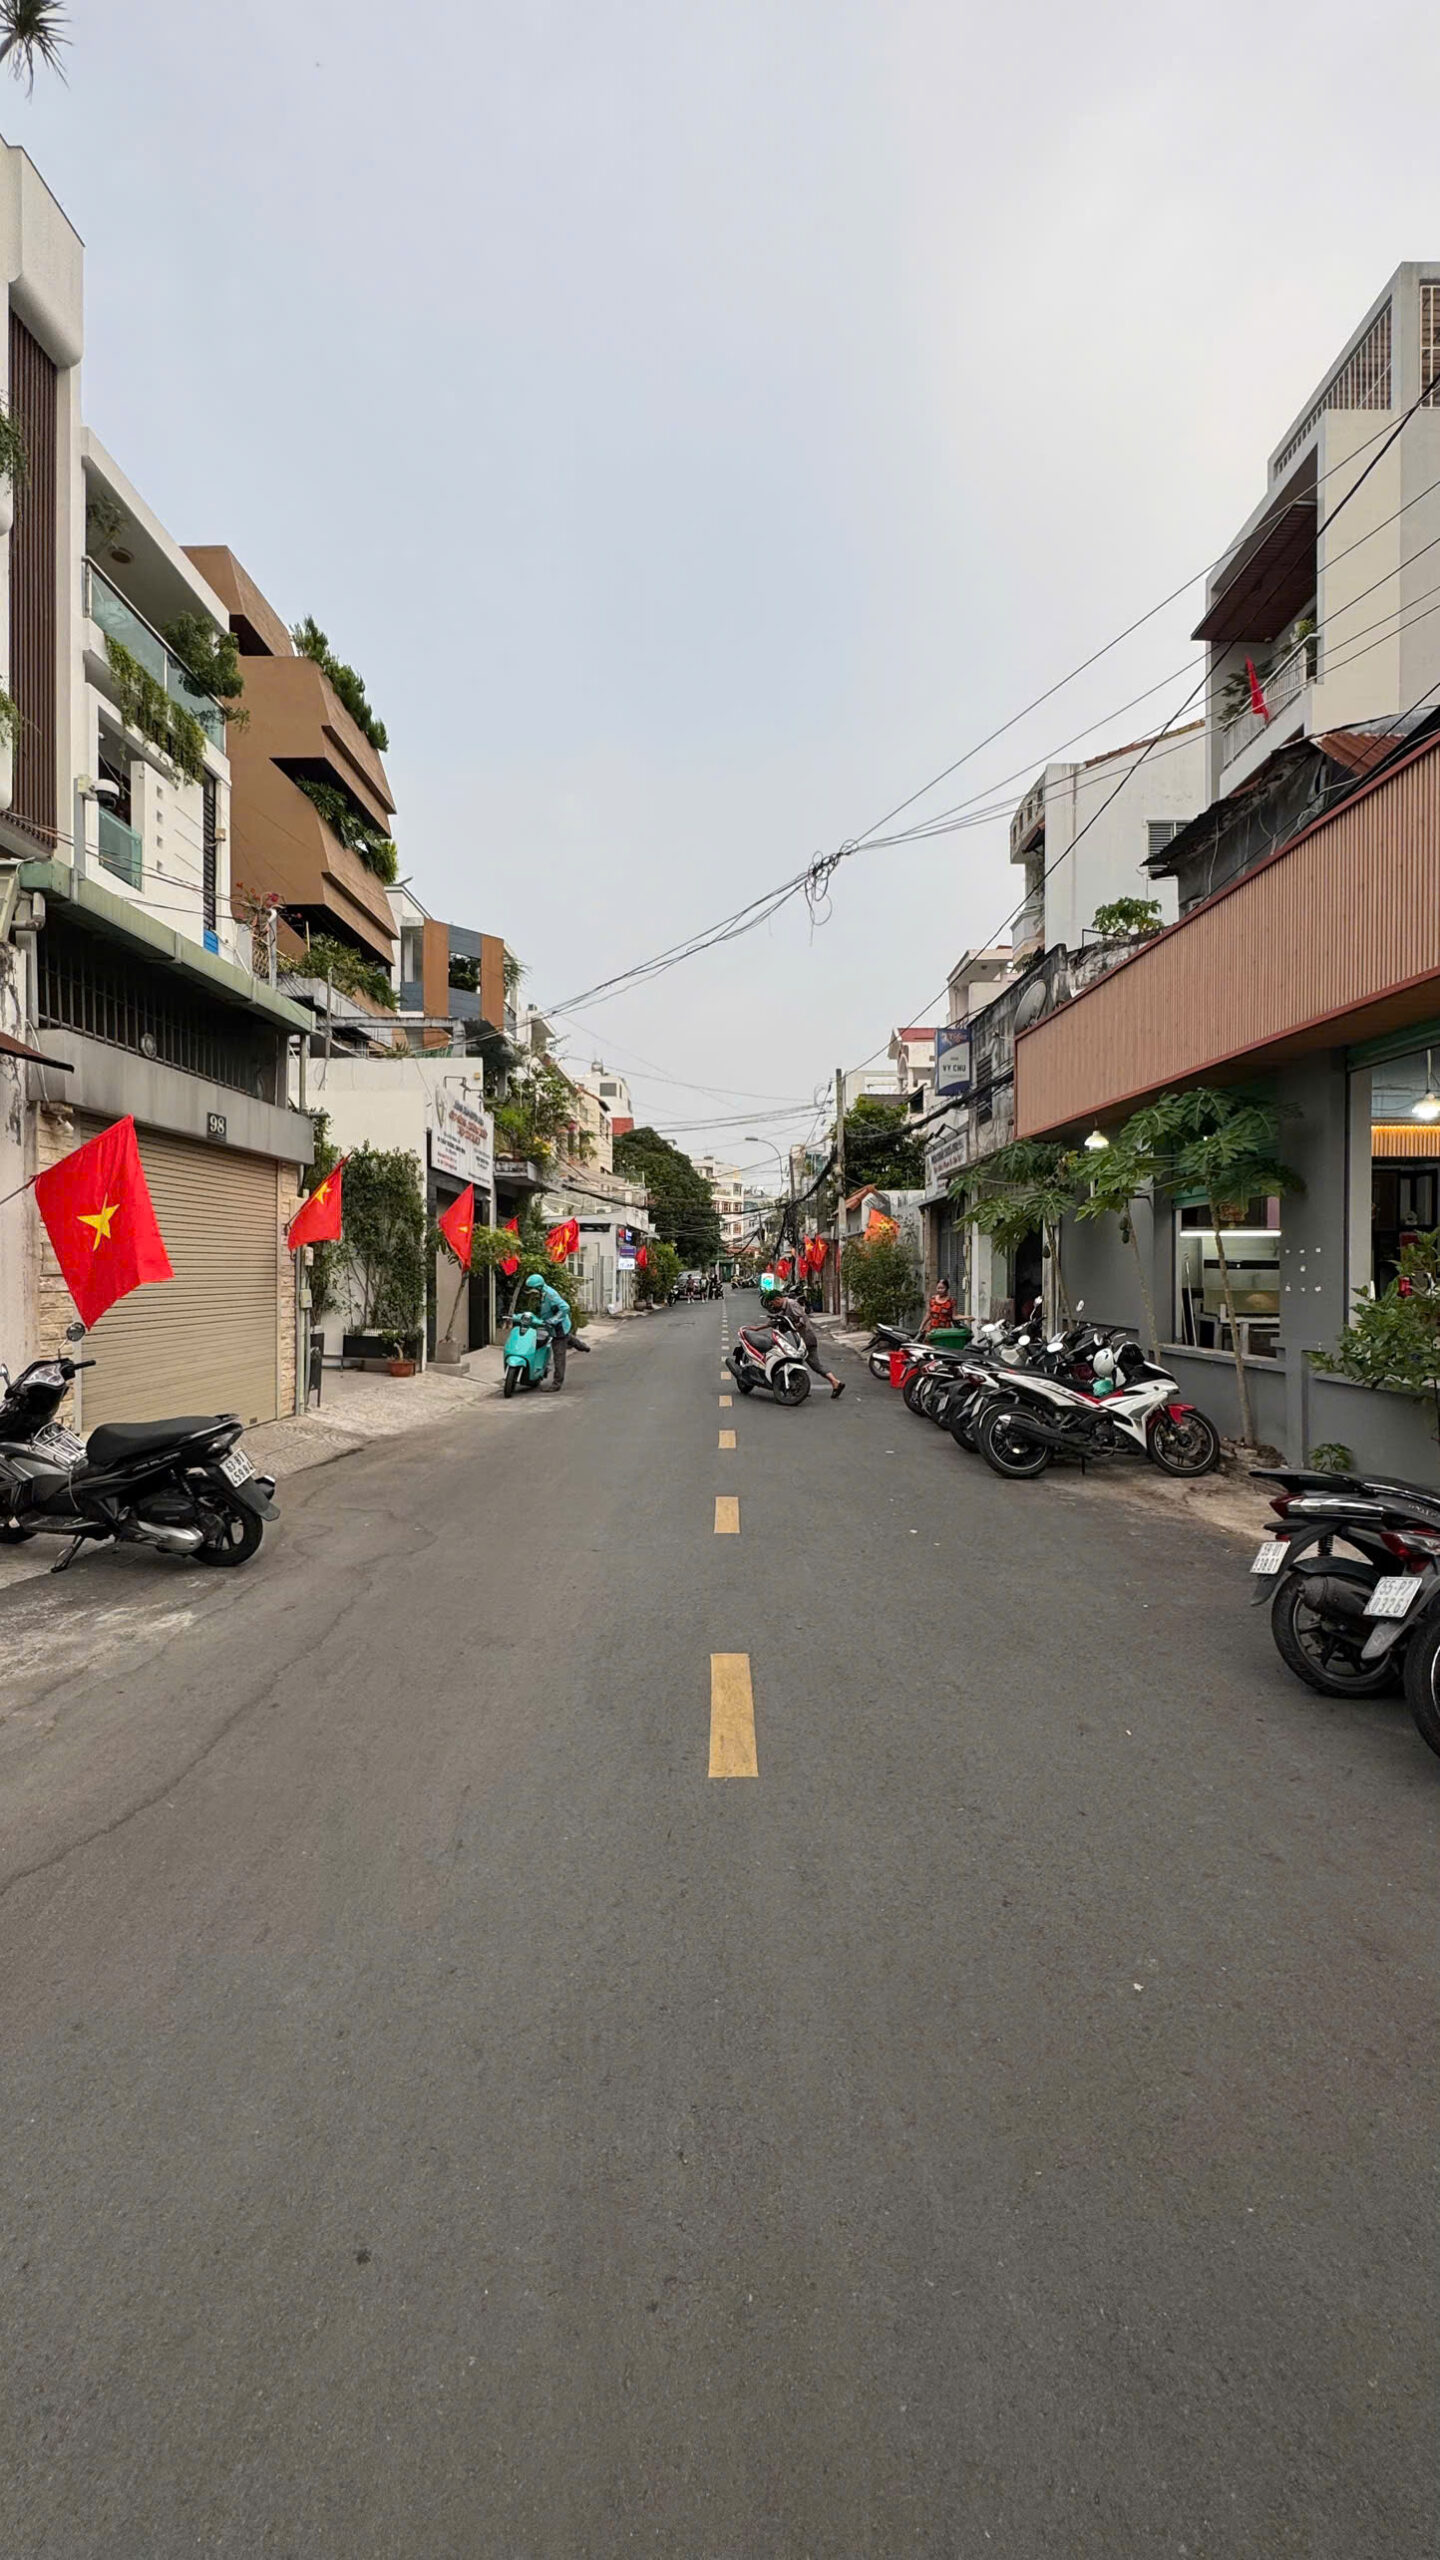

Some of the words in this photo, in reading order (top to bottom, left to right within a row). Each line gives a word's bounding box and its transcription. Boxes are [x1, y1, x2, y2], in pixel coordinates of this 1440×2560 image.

[952, 1064, 967, 1072] CHU
[210, 1115, 225, 1134] 98
[1379, 1580, 1413, 1596] 55-P7
